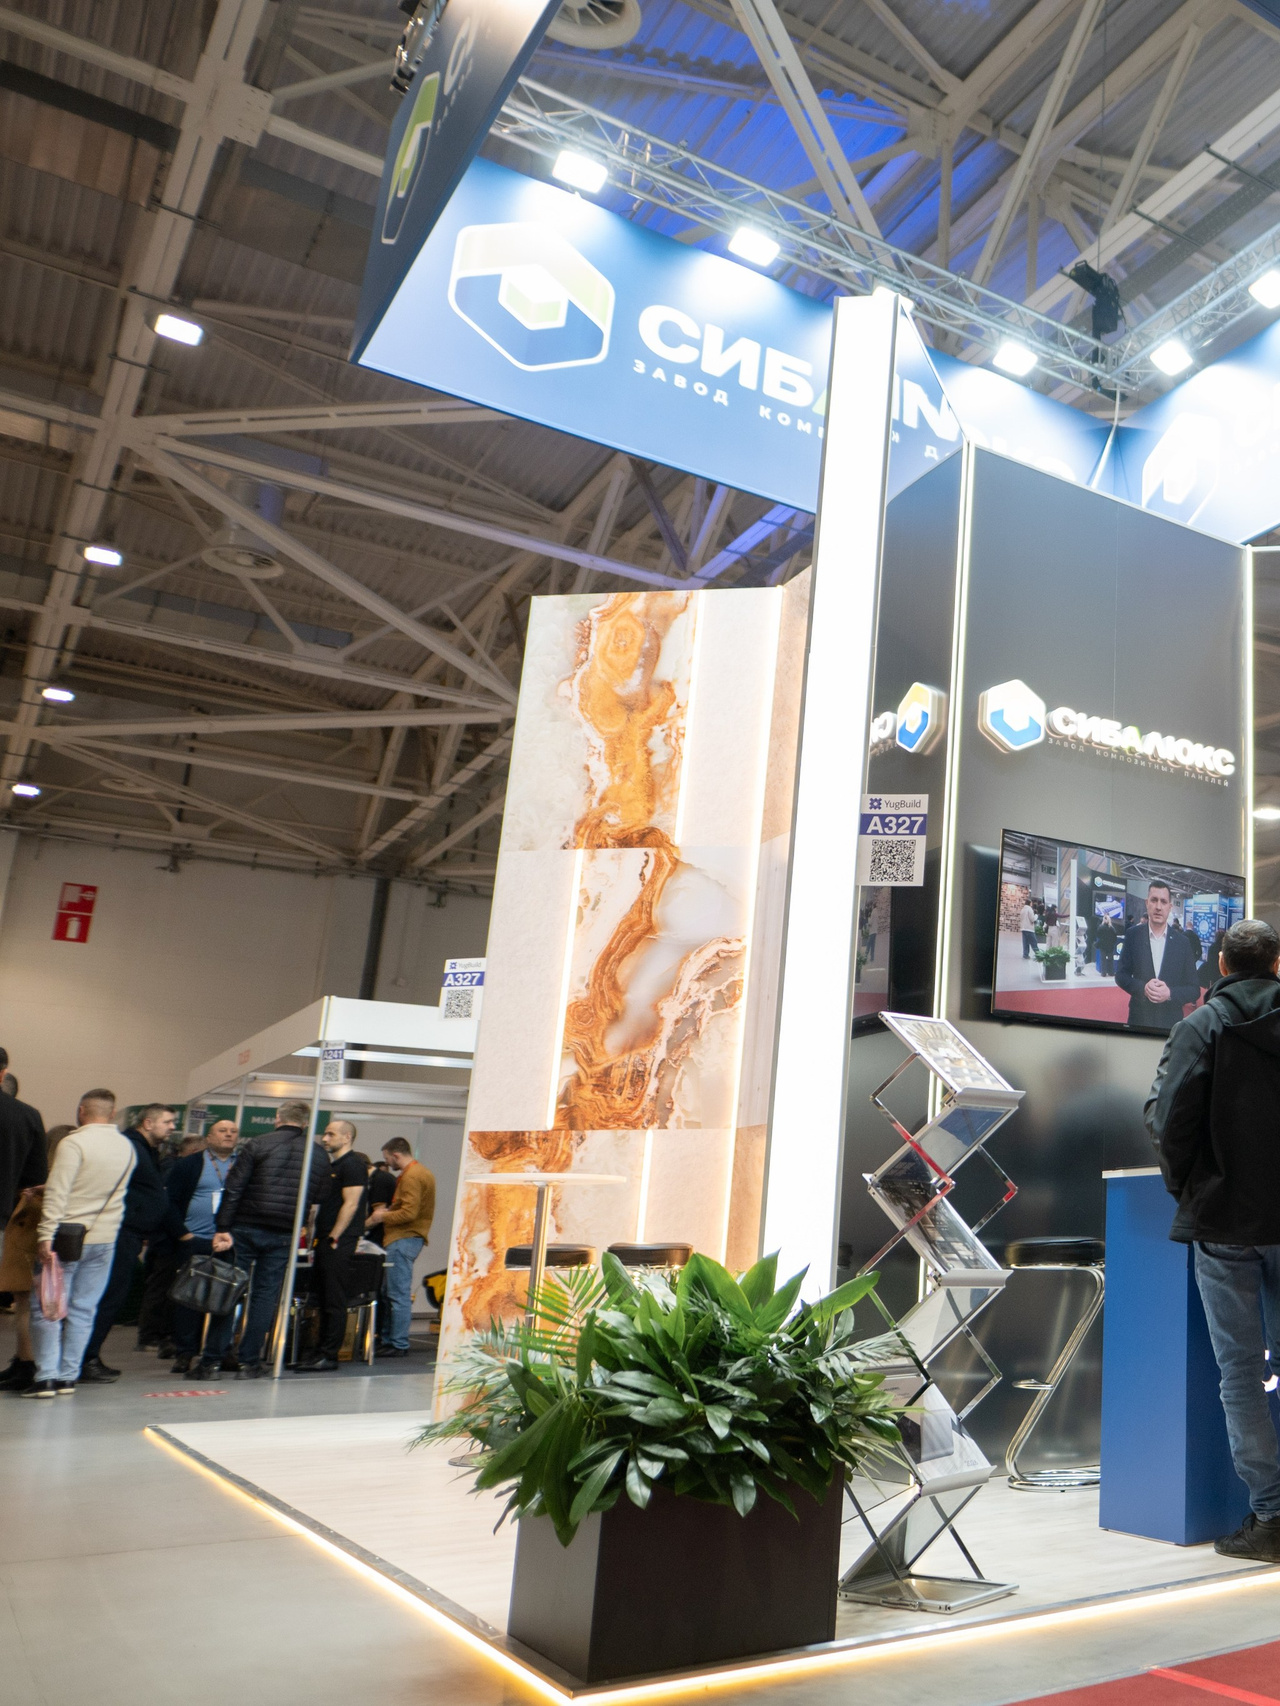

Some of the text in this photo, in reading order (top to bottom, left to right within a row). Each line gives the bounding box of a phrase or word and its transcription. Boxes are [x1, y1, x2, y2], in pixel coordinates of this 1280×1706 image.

[633, 358, 729, 406] ЗАВОД
[1050, 706, 1236, 776] СИБАЛЮКС
[1048, 737, 1229, 787] ЗАВОД КОМПОЗИТНЫХ ПАНЕЛЕЙ
[884, 800, 921, 811] YugBuild
[866, 816, 924, 835] A327
[443, 972, 481, 986] A327
[322, 1050, 344, 1060] A241
